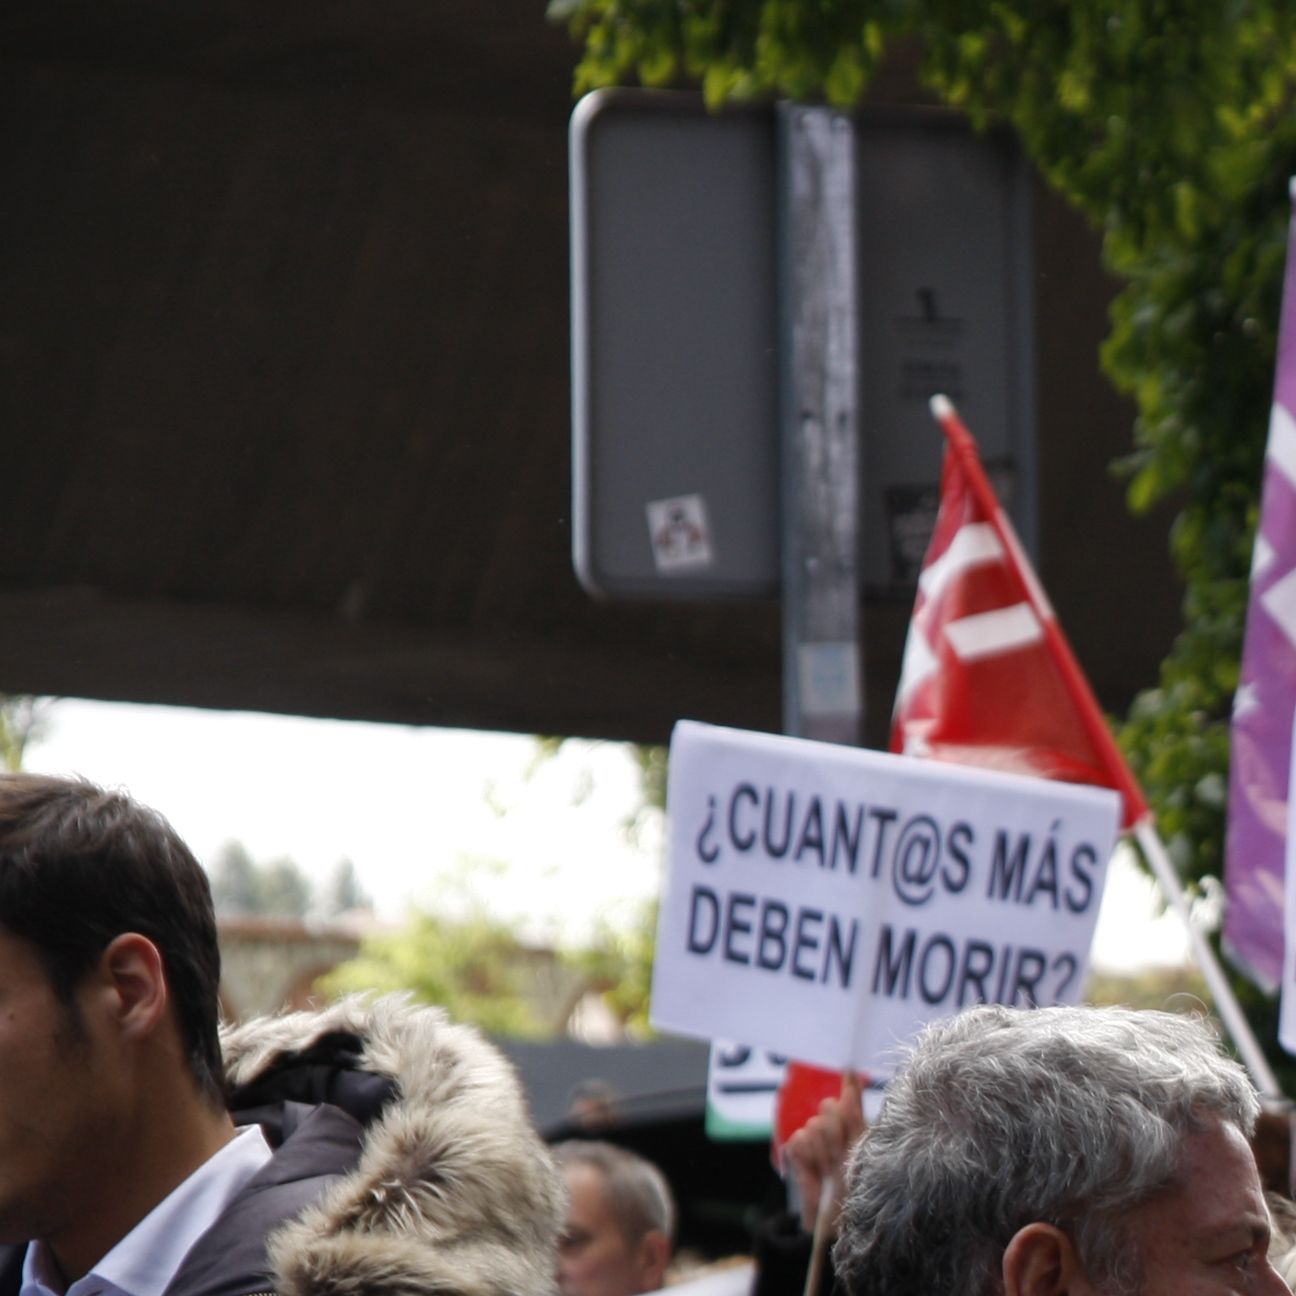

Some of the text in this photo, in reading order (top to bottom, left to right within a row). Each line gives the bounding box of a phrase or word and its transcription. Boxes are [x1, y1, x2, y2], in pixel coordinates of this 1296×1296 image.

[695, 782, 1099, 914] ¿CUANT@S MÁS
[685, 884, 1079, 1008] DEBEN MORIR?
